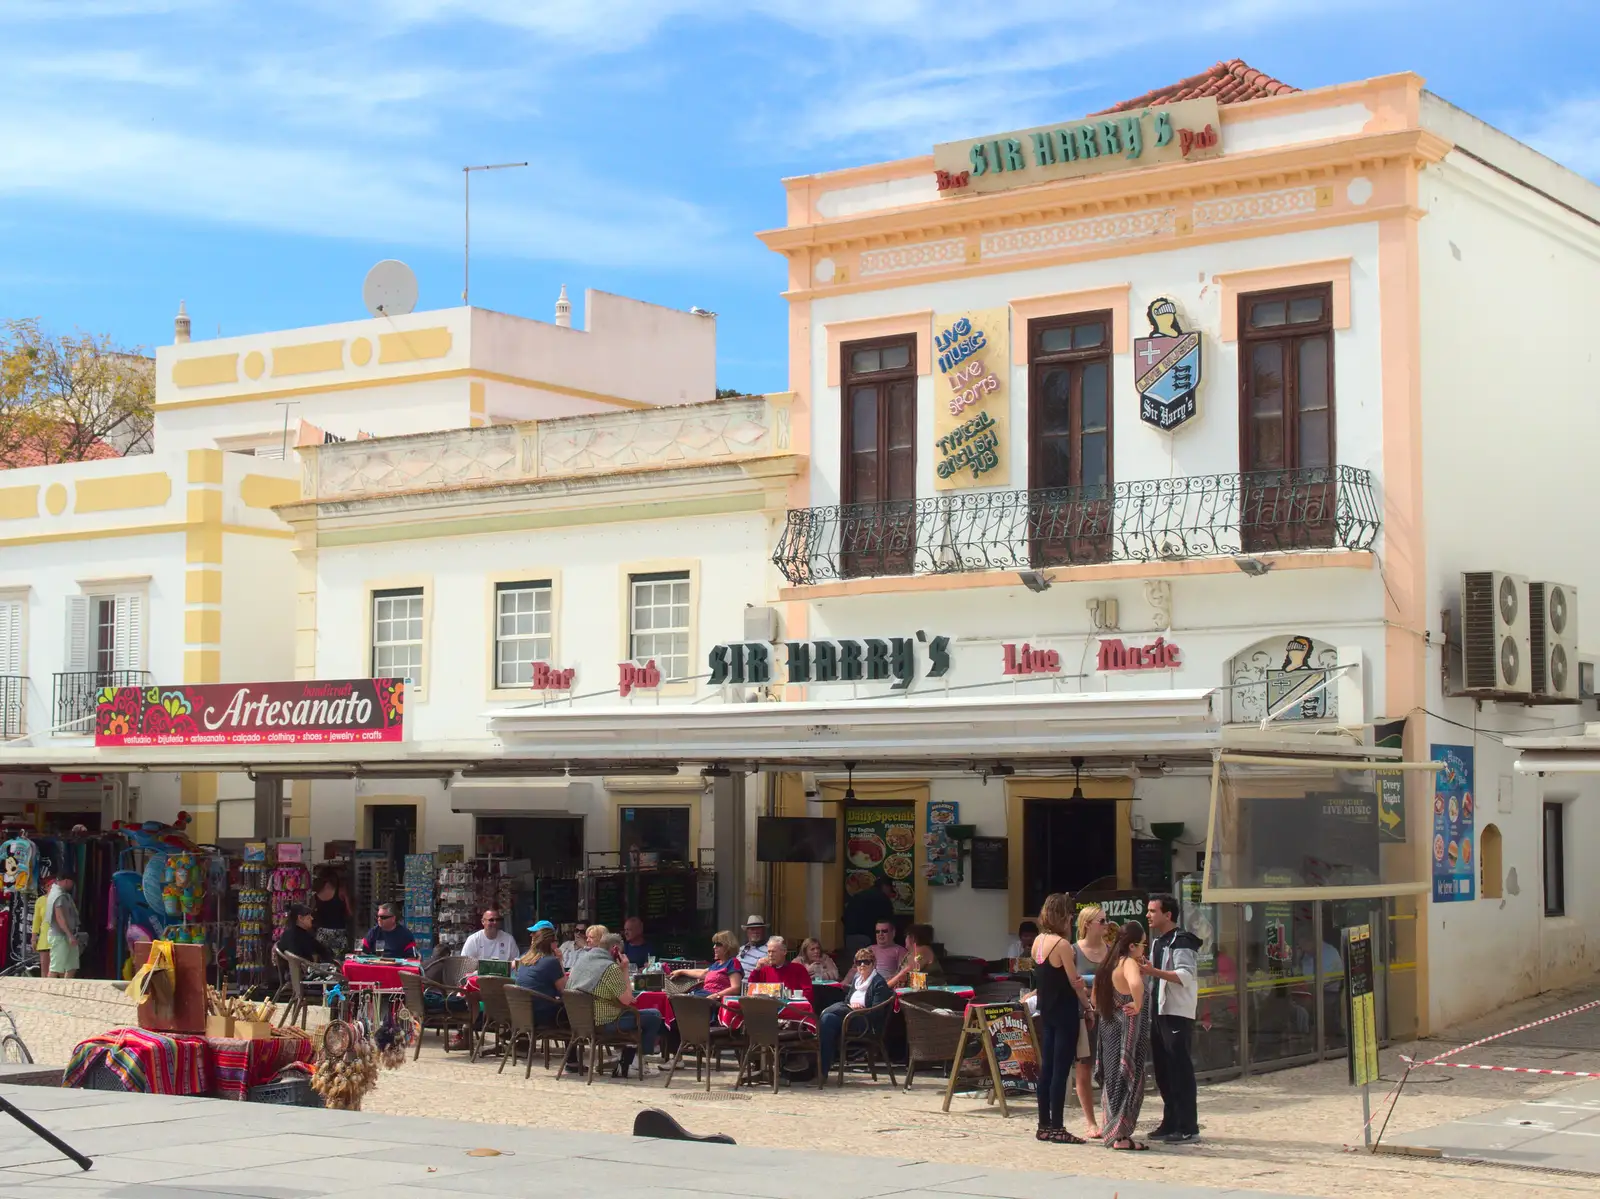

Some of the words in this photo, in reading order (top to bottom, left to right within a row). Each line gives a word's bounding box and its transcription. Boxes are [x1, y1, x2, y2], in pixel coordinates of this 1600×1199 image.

[934, 169, 969, 191] Bar
[969, 138, 1026, 177] SIR
[1028, 108, 1174, 166] HARRY'S
[1177, 124, 1218, 157] Pub
[1138, 366, 1162, 391] LIVE
[1161, 335, 1198, 367] MUSIC
[1142, 398, 1159, 421] Sir
[1160, 396, 1194, 428] Harry's
[968, 450, 998, 479] PUB
[530, 661, 576, 691] Bar
[616, 659, 662, 697] Pub
[706, 643, 770, 685] SIR
[784, 629, 950, 690] HARRY'S
[1002, 643, 1061, 675] Live
[1096, 636, 1182, 672] Music
[302, 683, 353, 697] handicraft
[203, 687, 372, 731] Artesanato
[157, 734, 184, 745] bijuteria
[190, 733, 226, 743] artesanato
[232, 732, 261, 744] calçado
[267, 732, 296, 743] clothing
[302, 732, 322, 741] shoes
[329, 731, 354, 743] jewelry
[361, 731, 382, 740] crafts
[1383, 780, 1401, 792] Every
[1383, 793, 1401, 805] Night
[847, 810, 873, 824] Daily
[875, 811, 915, 824] Specials
[1322, 806, 1343, 815] LIVE
[1344, 806, 1372, 815] MUSIC
[1101, 900, 1143, 916] PIZZAS
[1004, 1016, 1028, 1032] Music
[997, 1032, 1022, 1042] TONIGHT
